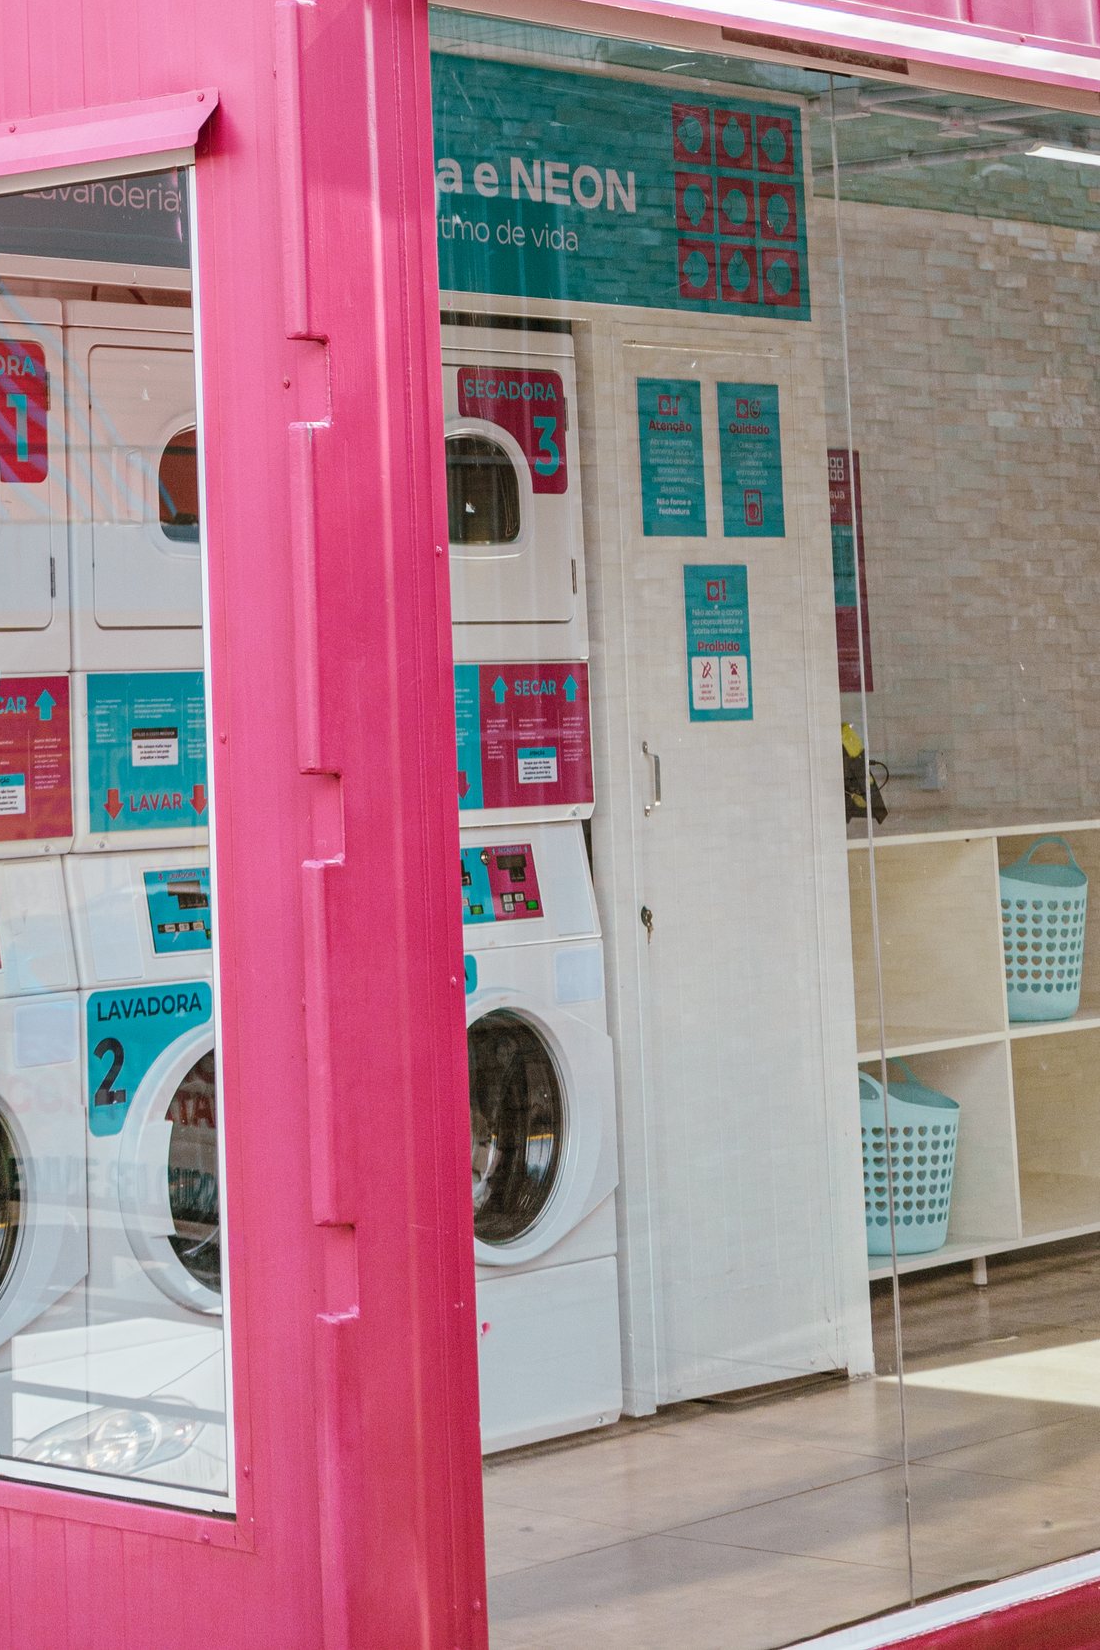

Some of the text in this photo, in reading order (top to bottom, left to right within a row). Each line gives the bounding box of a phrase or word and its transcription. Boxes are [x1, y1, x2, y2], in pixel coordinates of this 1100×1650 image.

[23, 178, 181, 213] avanderia
[473, 162, 499, 197] e
[510, 156, 637, 213] NEON
[496, 219, 526, 246] de
[531, 223, 579, 251] vida
[464, 378, 557, 402] SECADORA
[6, 393, 29, 462] 1
[648, 419, 693, 434] Atenção
[728, 422, 770, 435] Cuidado
[533, 415, 560, 477] 3
[697, 640, 741, 652] Proibido
[514, 679, 557, 696] SECAR
[129, 792, 183, 813] LAVAR
[97, 992, 202, 1022] LAVADORA
[93, 1037, 127, 1107] 2
